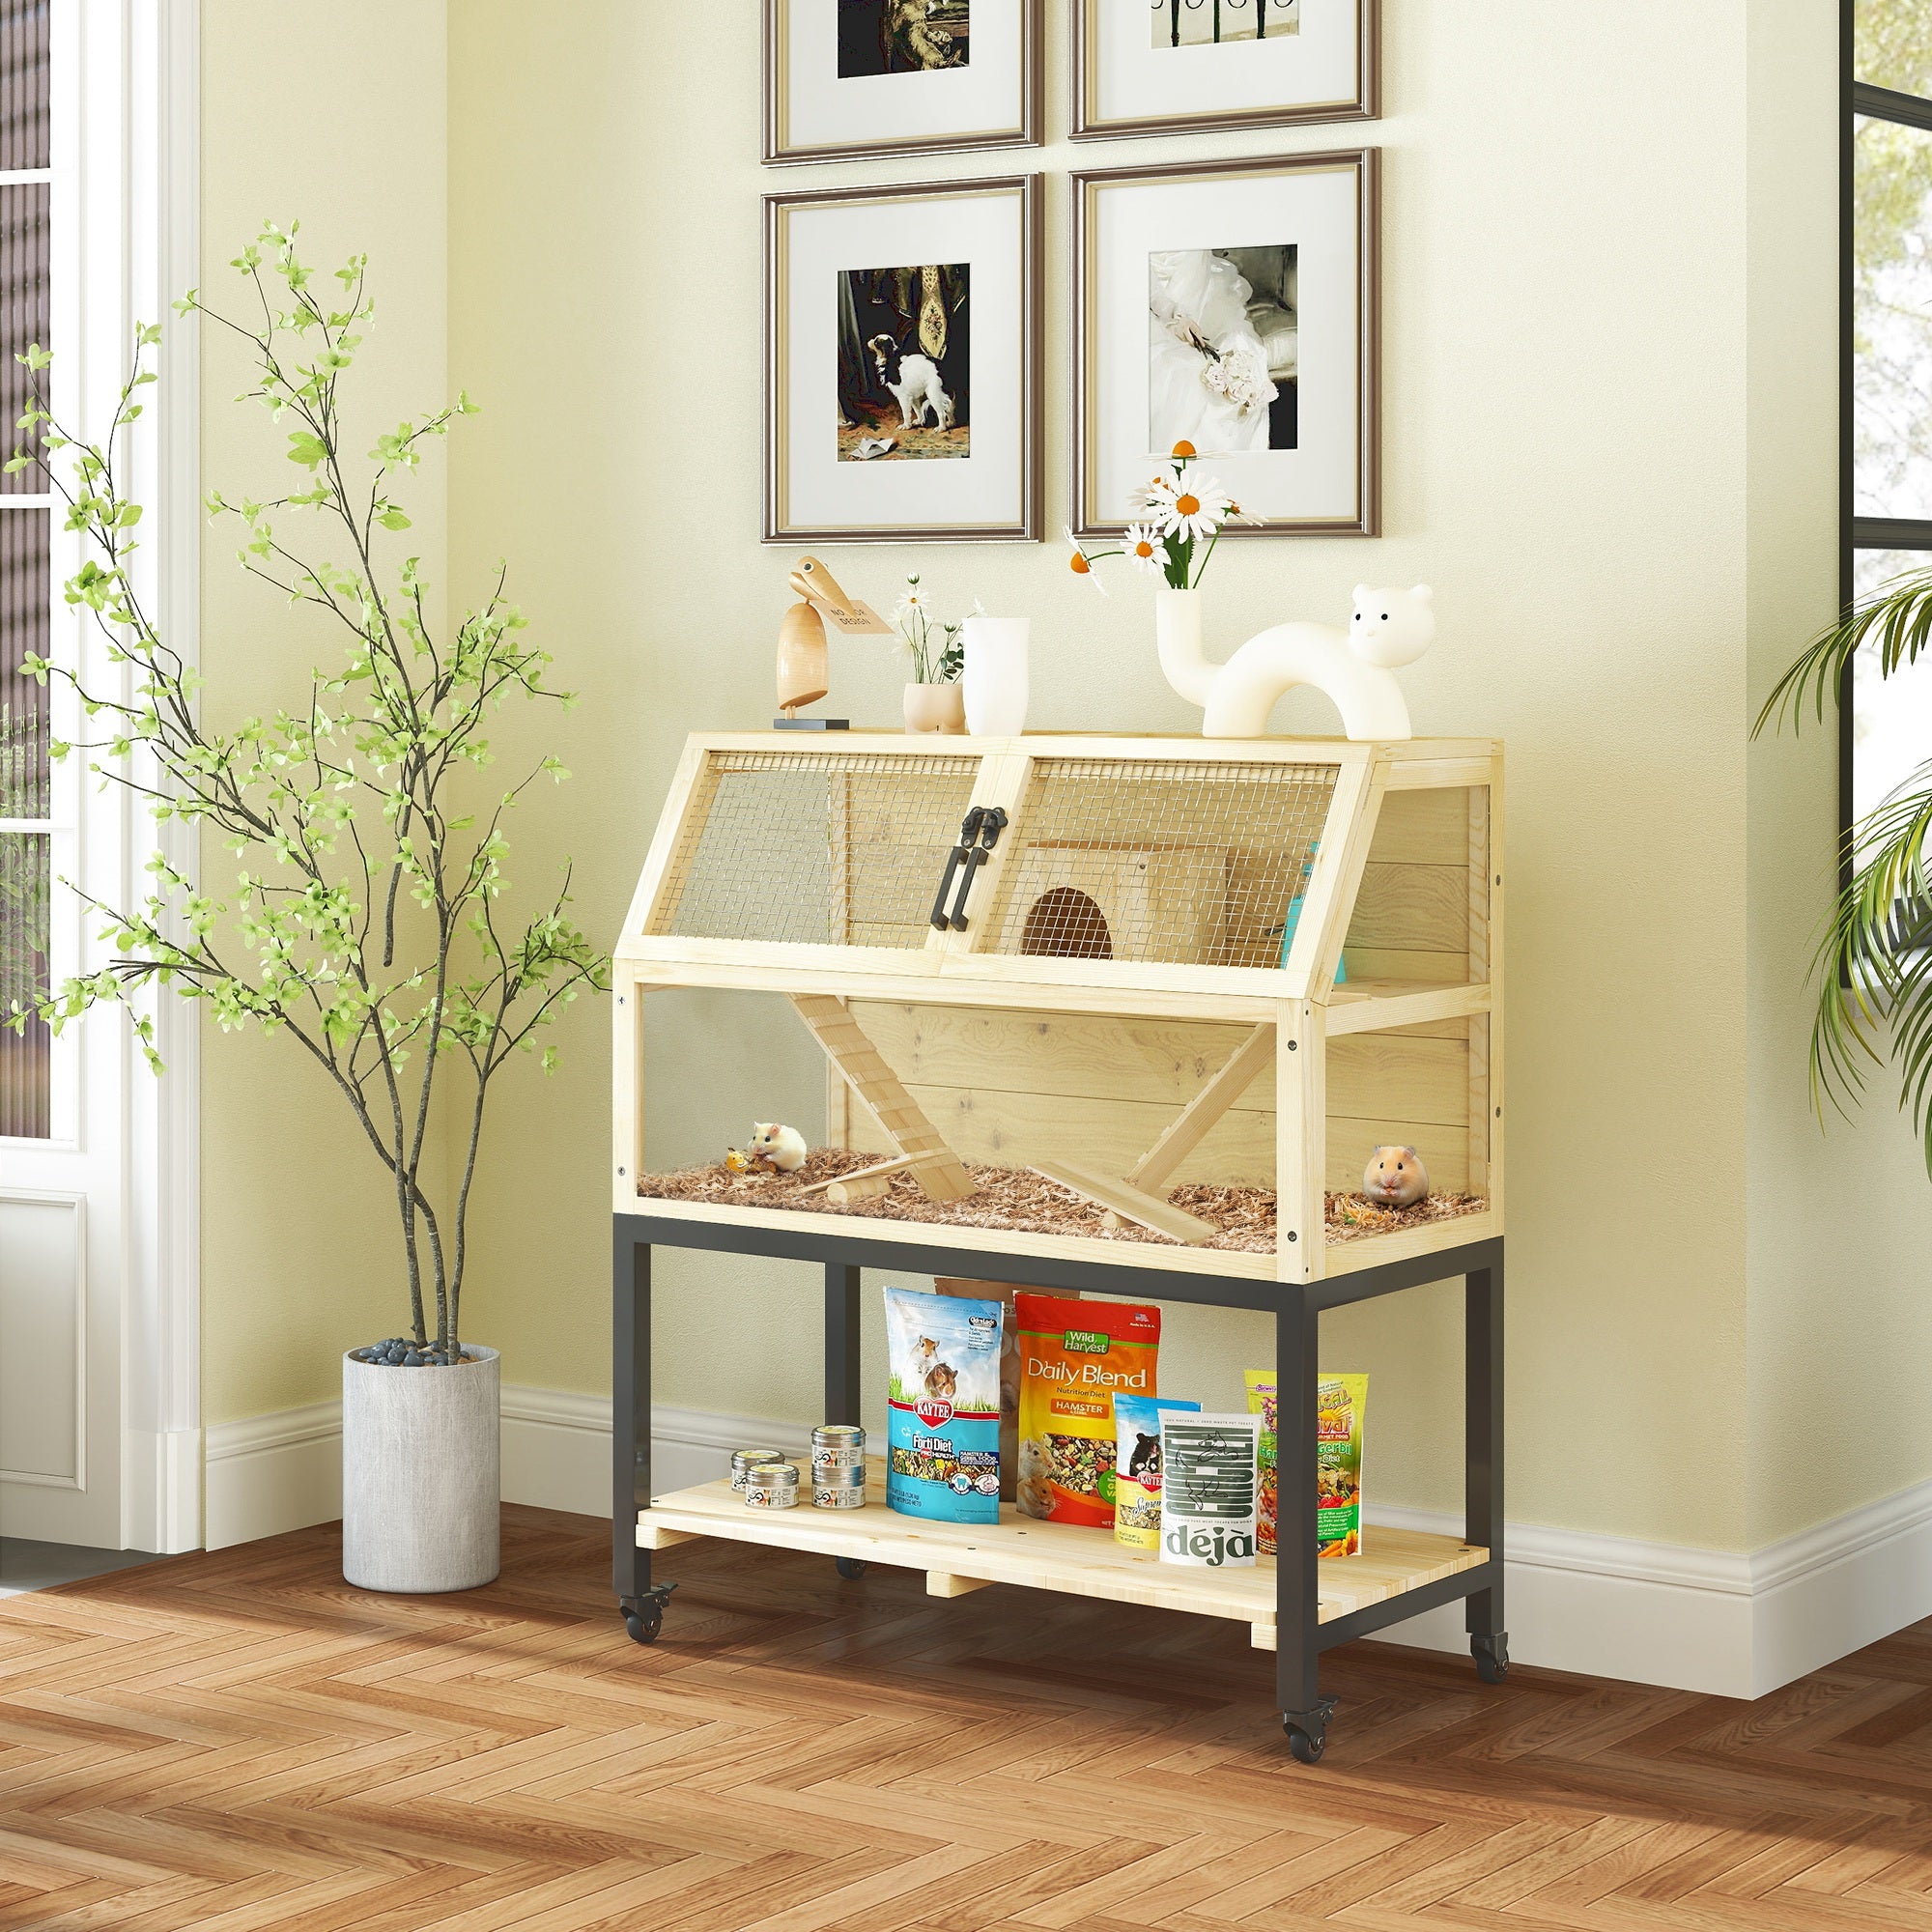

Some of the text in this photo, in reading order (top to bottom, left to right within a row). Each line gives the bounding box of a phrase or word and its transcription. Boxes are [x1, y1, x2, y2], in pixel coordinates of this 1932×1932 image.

[1069, 1331, 1095, 1344] Wild
[1064, 1339, 1107, 1353] Harvest
[1028, 1357, 1147, 1388] Daily Blend
[1056, 1387, 1089, 1397] Nutrition
[917, 1401, 951, 1419] KAYTEE
[1056, 1401, 1103, 1413] HAMSTER
[913, 1435, 952, 1453] Forti Diet
[1322, 1454, 1341, 1463] Diet
[1140, 1475, 1162, 1487] KAYTE
[1132, 1496, 1162, 1515] Suprem
[1166, 1524, 1255, 1567] déjà
